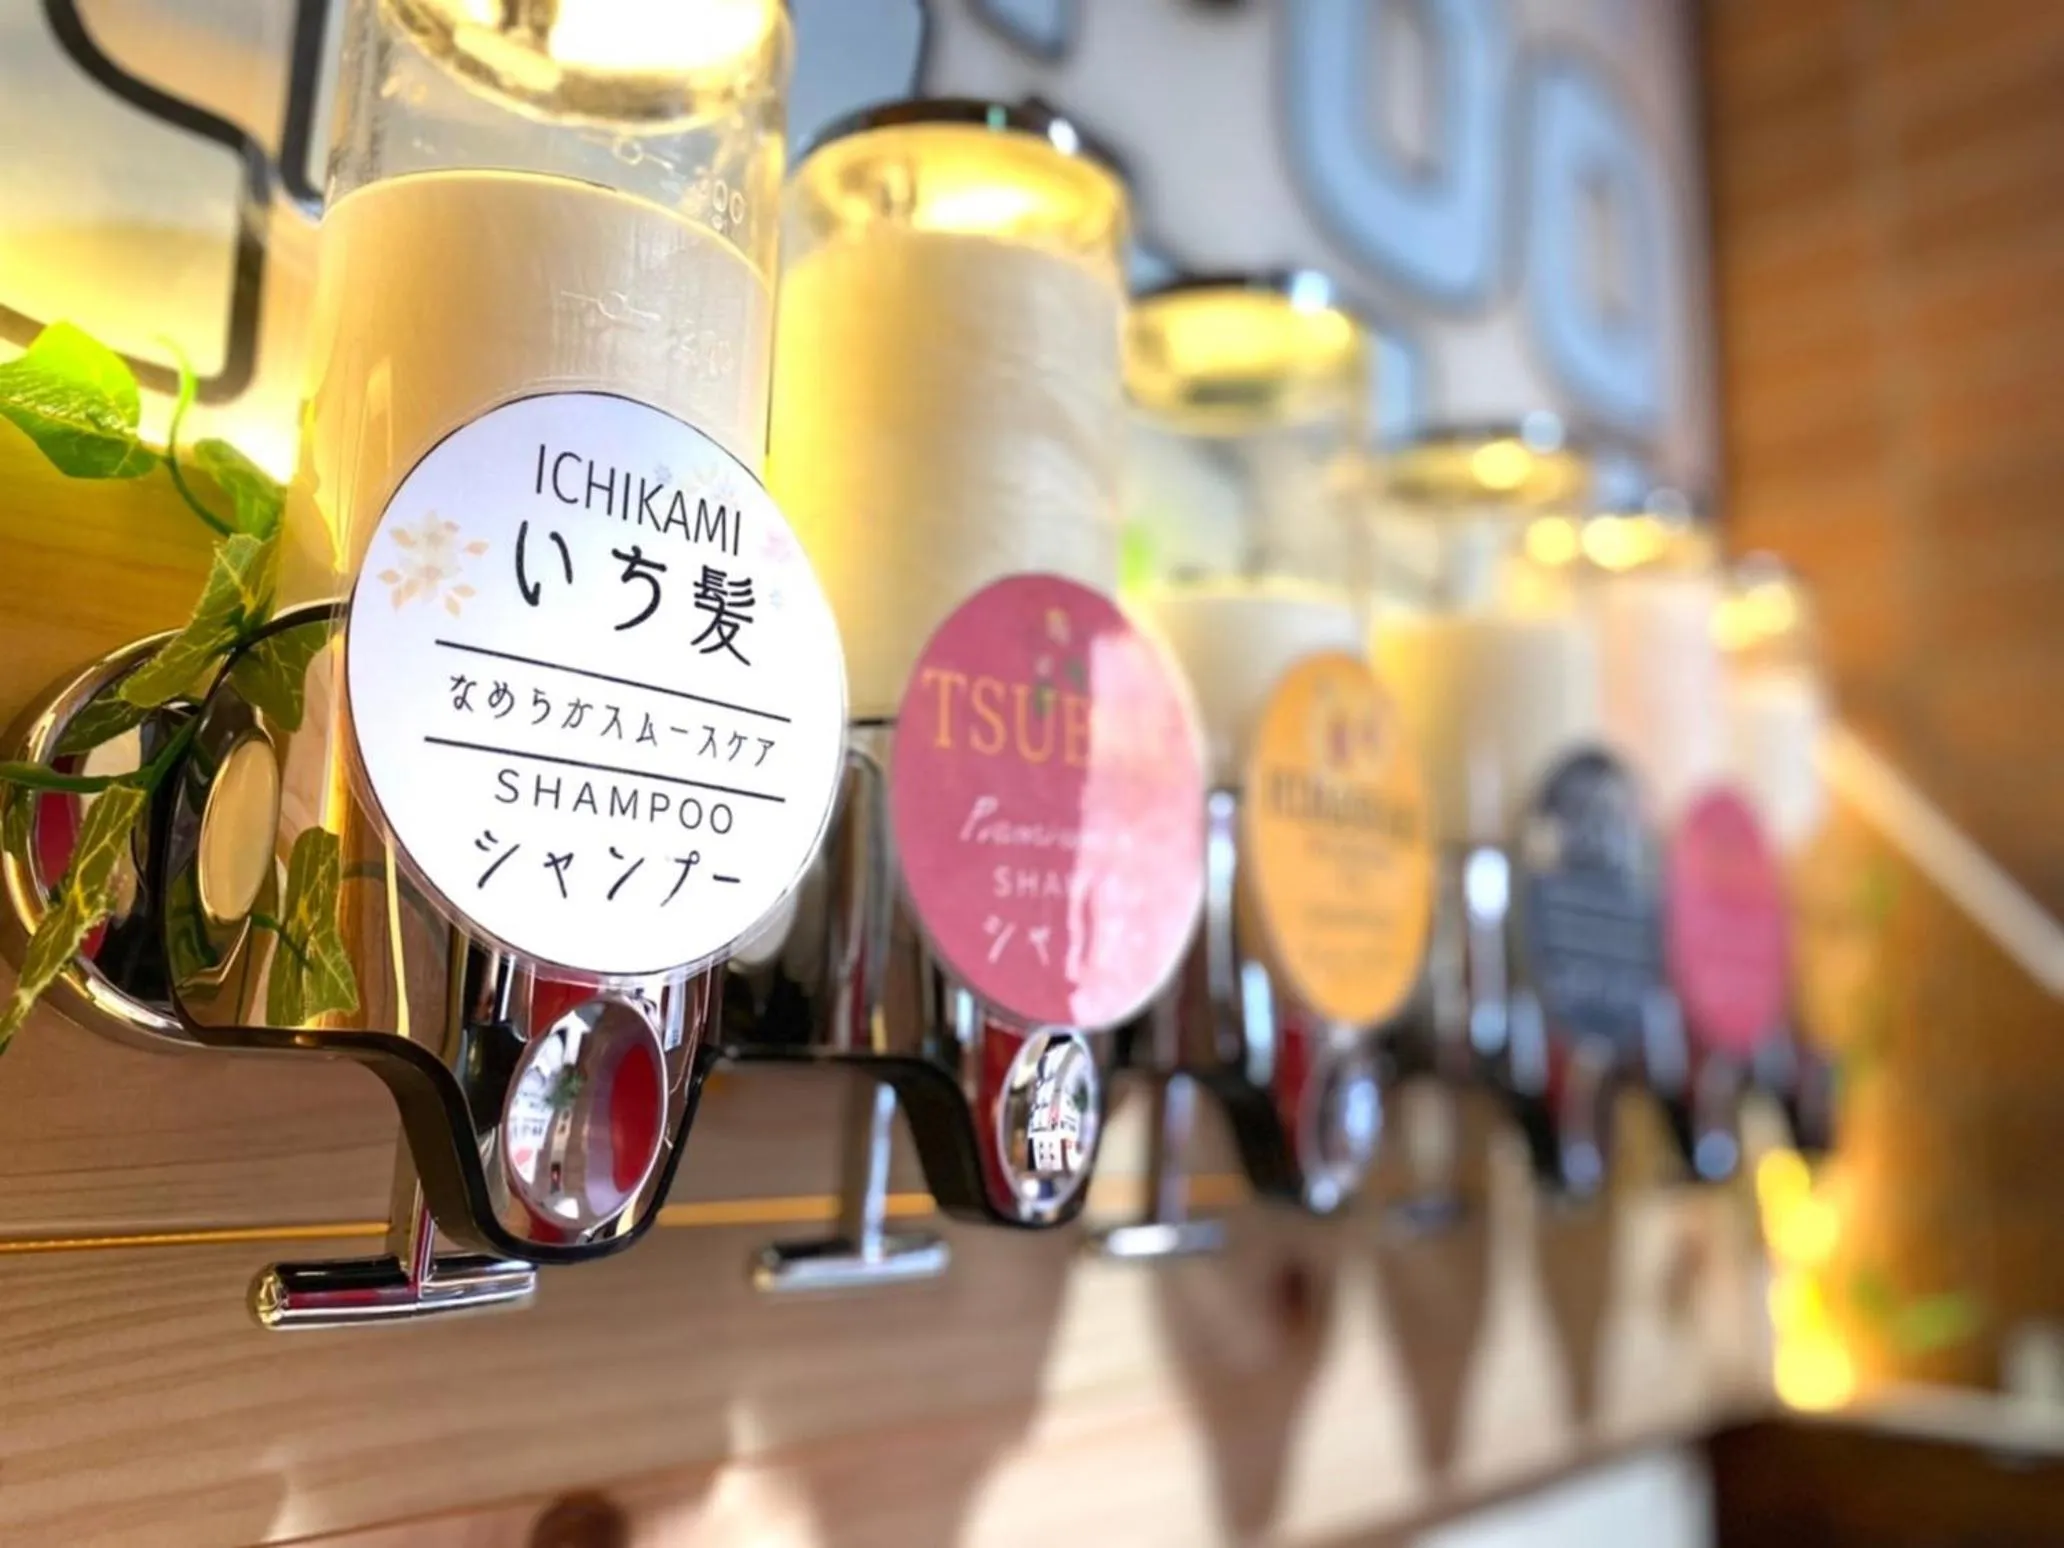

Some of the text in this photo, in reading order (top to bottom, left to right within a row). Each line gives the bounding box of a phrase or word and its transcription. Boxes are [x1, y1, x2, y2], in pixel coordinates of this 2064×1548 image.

[536, 444, 742, 557] ICHIKAMI
[515, 519, 756, 667] いち髪
[449, 673, 776, 768] なめらかスムースケア
[494, 768, 734, 835] SHAMPOO
[474, 830, 742, 908] シャンプー
